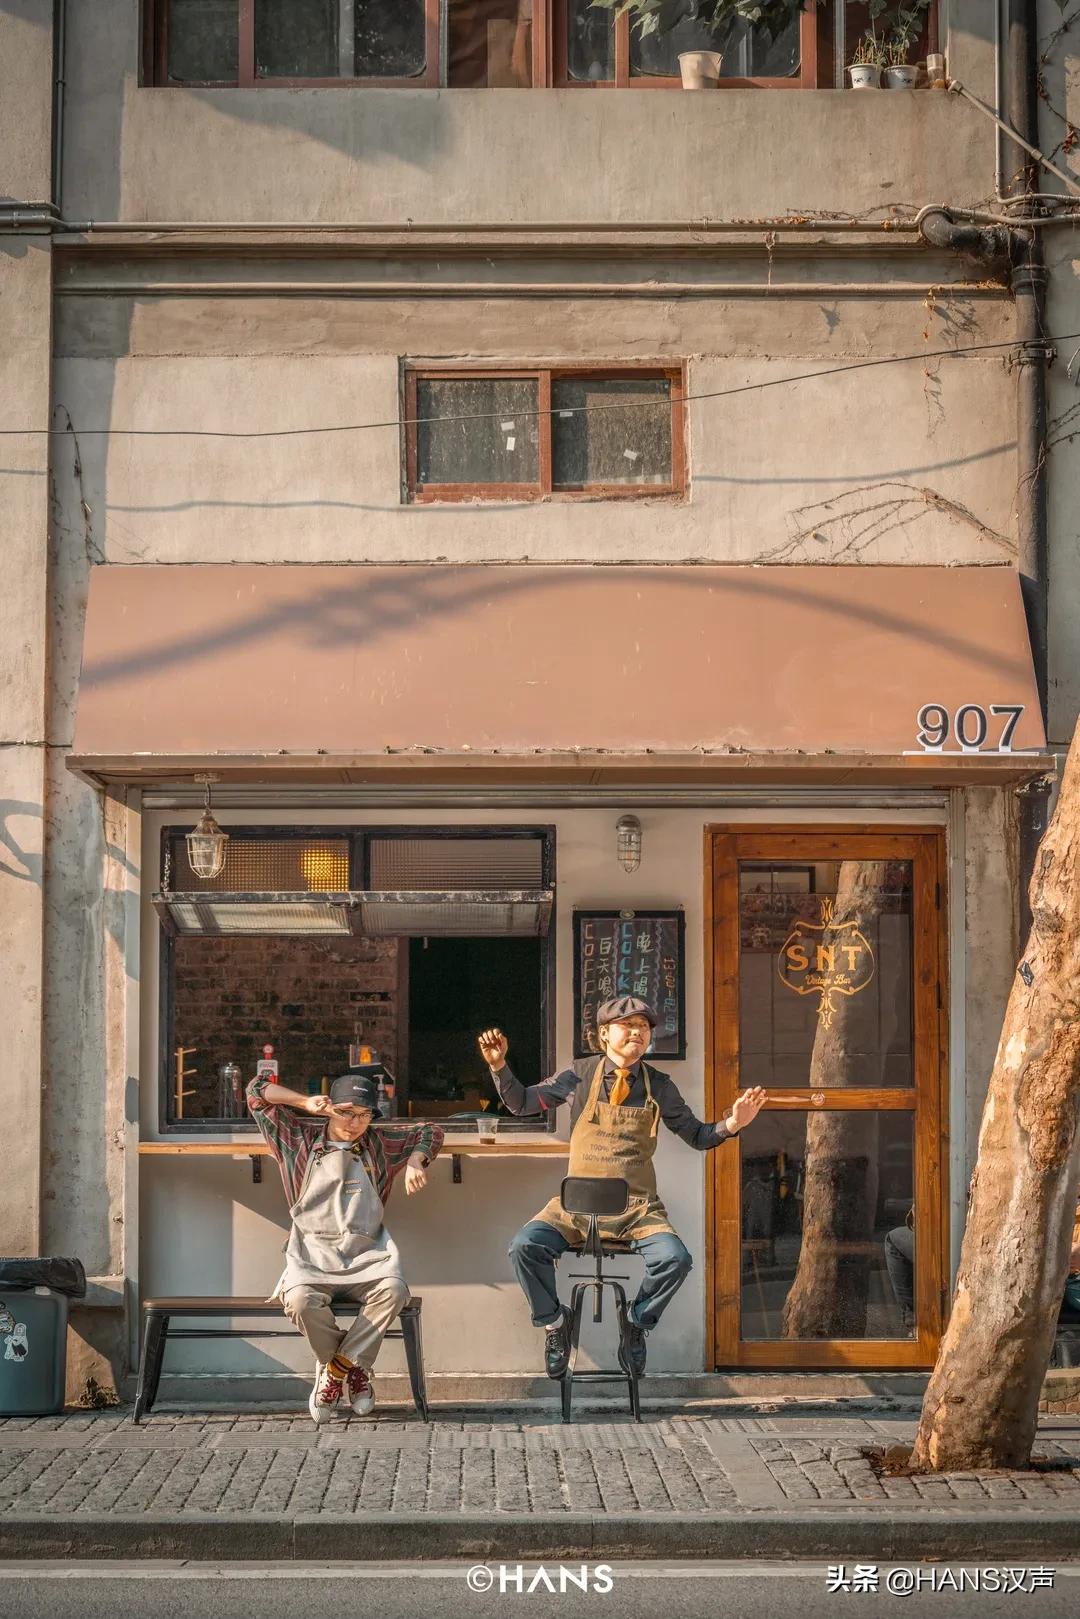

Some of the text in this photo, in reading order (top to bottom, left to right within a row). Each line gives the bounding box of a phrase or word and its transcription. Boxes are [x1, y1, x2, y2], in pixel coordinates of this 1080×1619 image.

[916, 703, 1025, 748] 907
[618, 922, 633, 998] COCK
[787, 944, 862, 972] SNT
[805, 974, 851, 986] Vintage Bar
